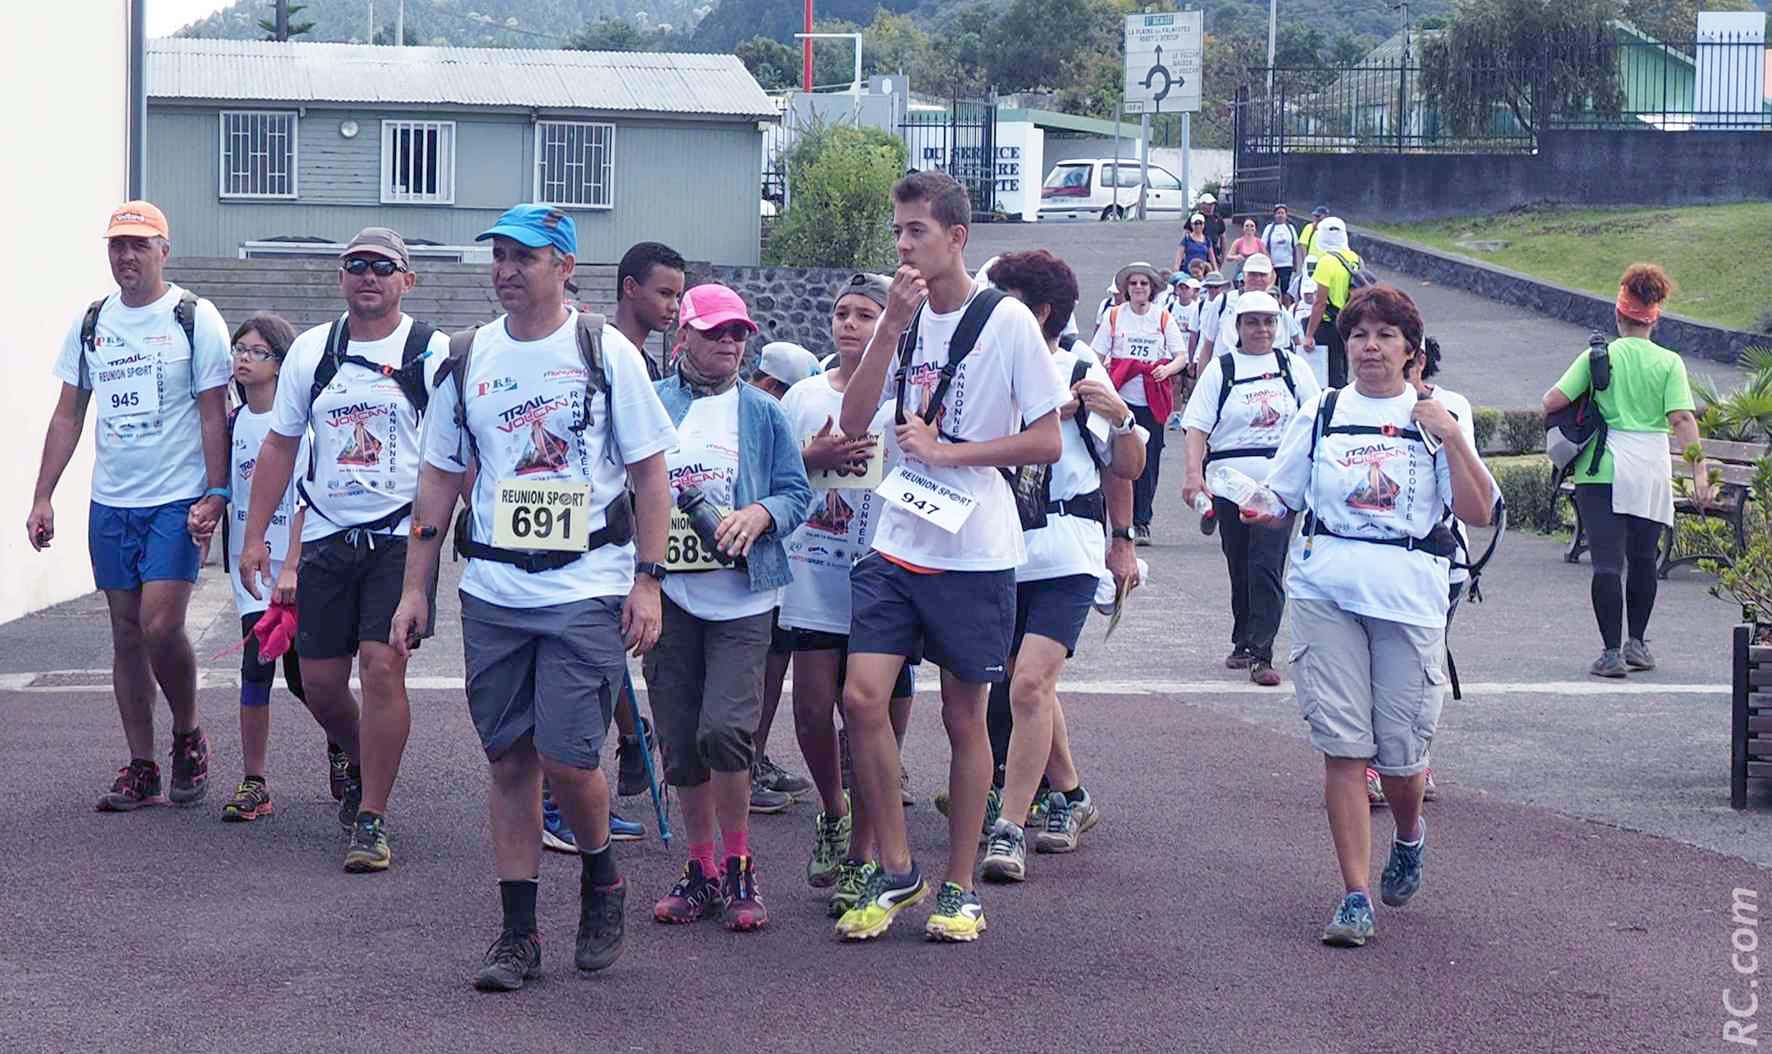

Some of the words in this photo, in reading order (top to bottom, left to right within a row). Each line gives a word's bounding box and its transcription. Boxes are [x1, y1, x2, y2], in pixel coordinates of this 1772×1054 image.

[1129, 344, 1150, 358] 275
[111, 391, 140, 409] 945
[327, 401, 376, 419] TRAIL
[498, 394, 555, 423] TRAIL
[497, 398, 569, 434] VOLCAN
[1344, 442, 1394, 458] TRAIL
[900, 469, 939, 495] REUNION
[501, 488, 545, 506] REUNION
[901, 491, 940, 515] 947
[511, 505, 573, 540] 691
